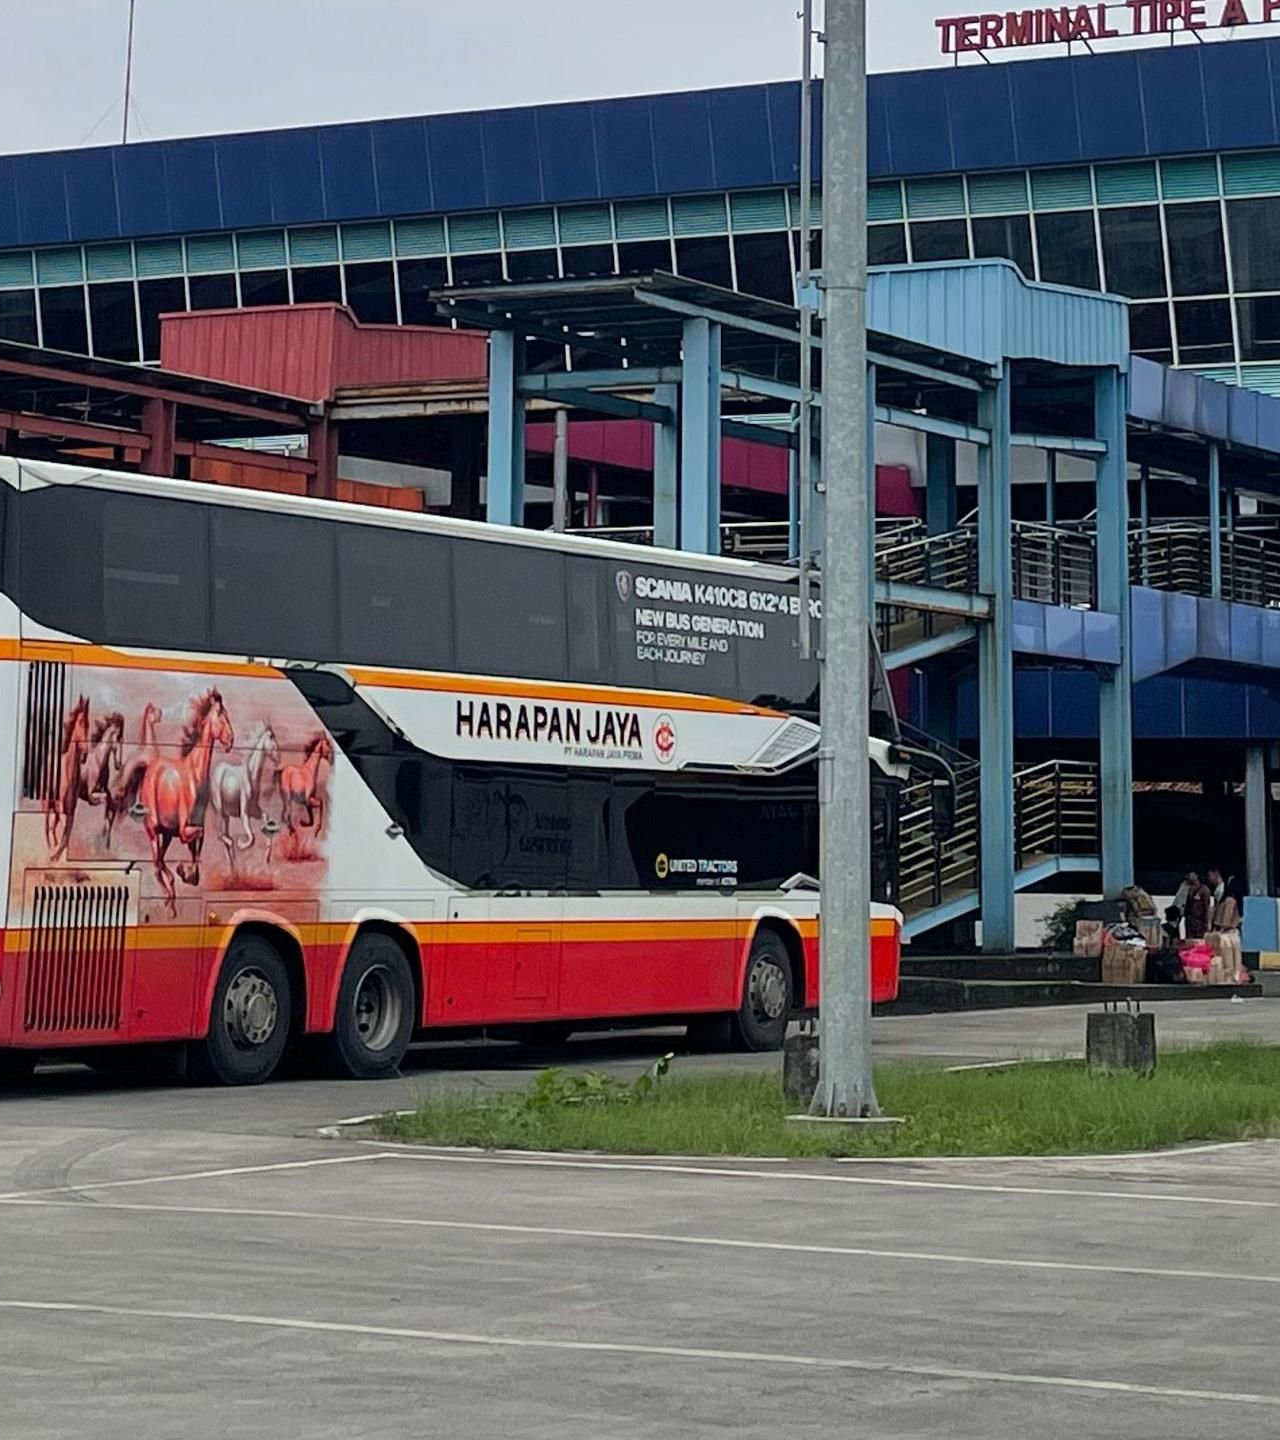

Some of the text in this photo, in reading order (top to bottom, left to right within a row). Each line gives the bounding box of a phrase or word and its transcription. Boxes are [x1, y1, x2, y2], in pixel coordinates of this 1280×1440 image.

[935, 3, 1118, 53] TERMINAL
[635, 576, 693, 602] SCANIA
[694, 583, 747, 609] K410CB
[789, 595, 822, 619] ERO
[635, 608, 764, 639] NEW BUS GENERATION
[636, 630, 728, 653] FOR EVERY MILE AND
[637, 646, 707, 666] EACH JOURNEY
[456, 699, 643, 748] HARAPAN JAYA
[574, 747, 605, 759] HARAPAN
[669, 859, 738, 873] UNITED TRACTORS
